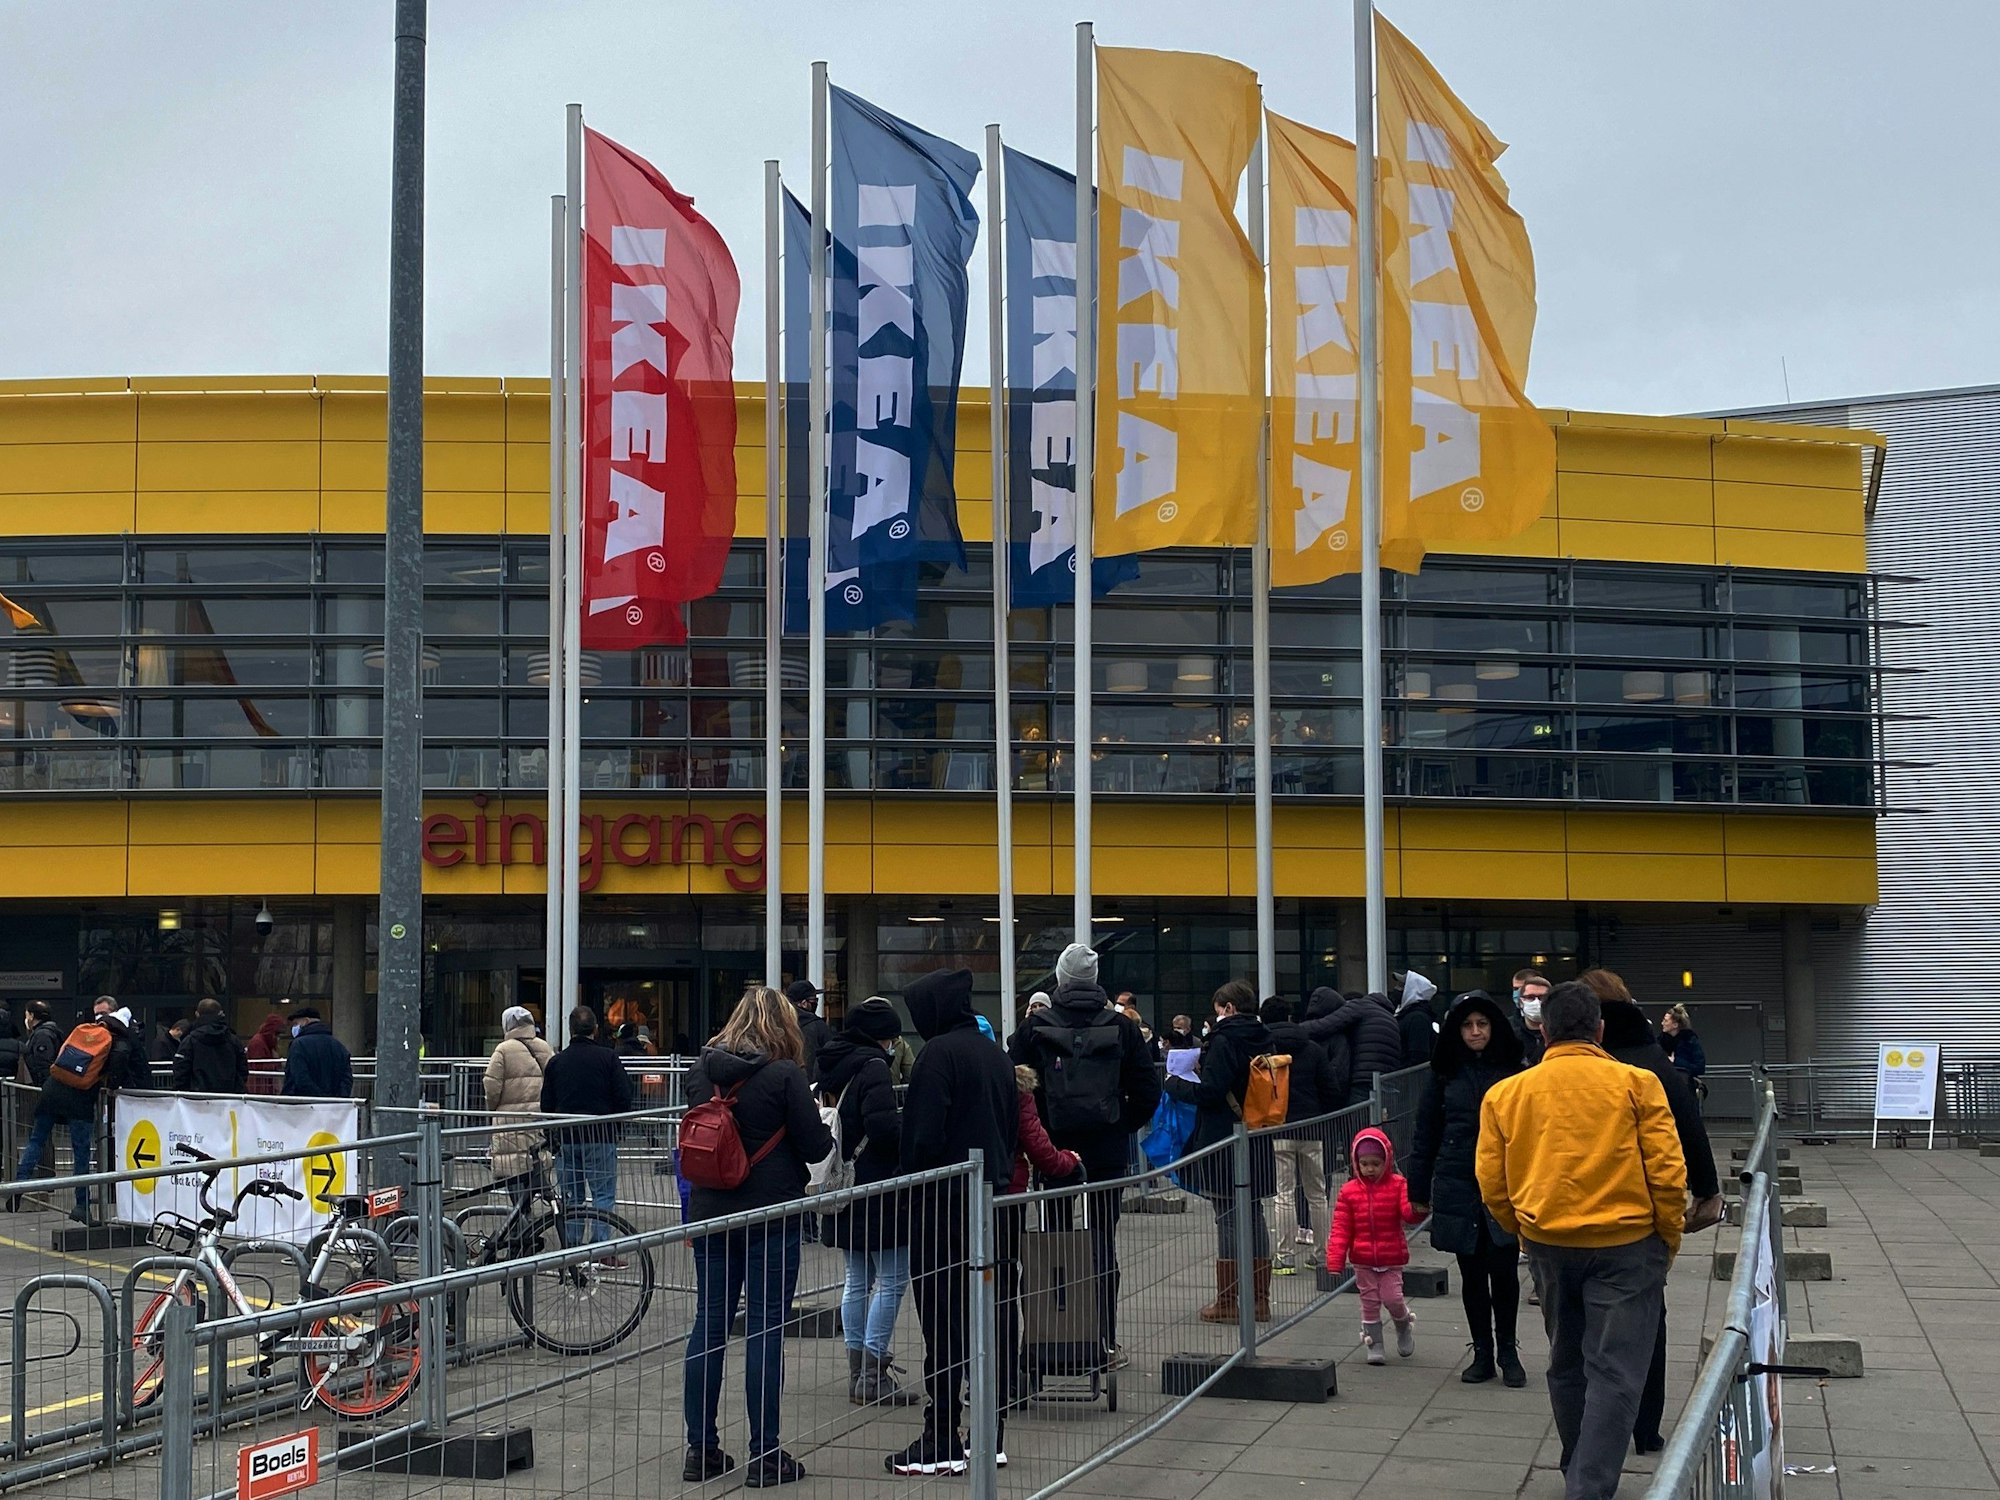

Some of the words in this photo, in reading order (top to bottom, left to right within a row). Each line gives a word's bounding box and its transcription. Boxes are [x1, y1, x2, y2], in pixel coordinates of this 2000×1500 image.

[604, 225, 667, 564] IKEA
[851, 184, 917, 540] IKEA
[1115, 145, 1184, 521] IKEA
[1293, 205, 1357, 555] IKEA
[1406, 120, 1482, 503] IKEA
[421, 793, 767, 892] eingang
[257, 1137, 284, 1152] Eingang
[259, 1168, 284, 1180] Einkauf
[375, 1193, 397, 1206] Boels
[252, 1445, 306, 1477] Boels
